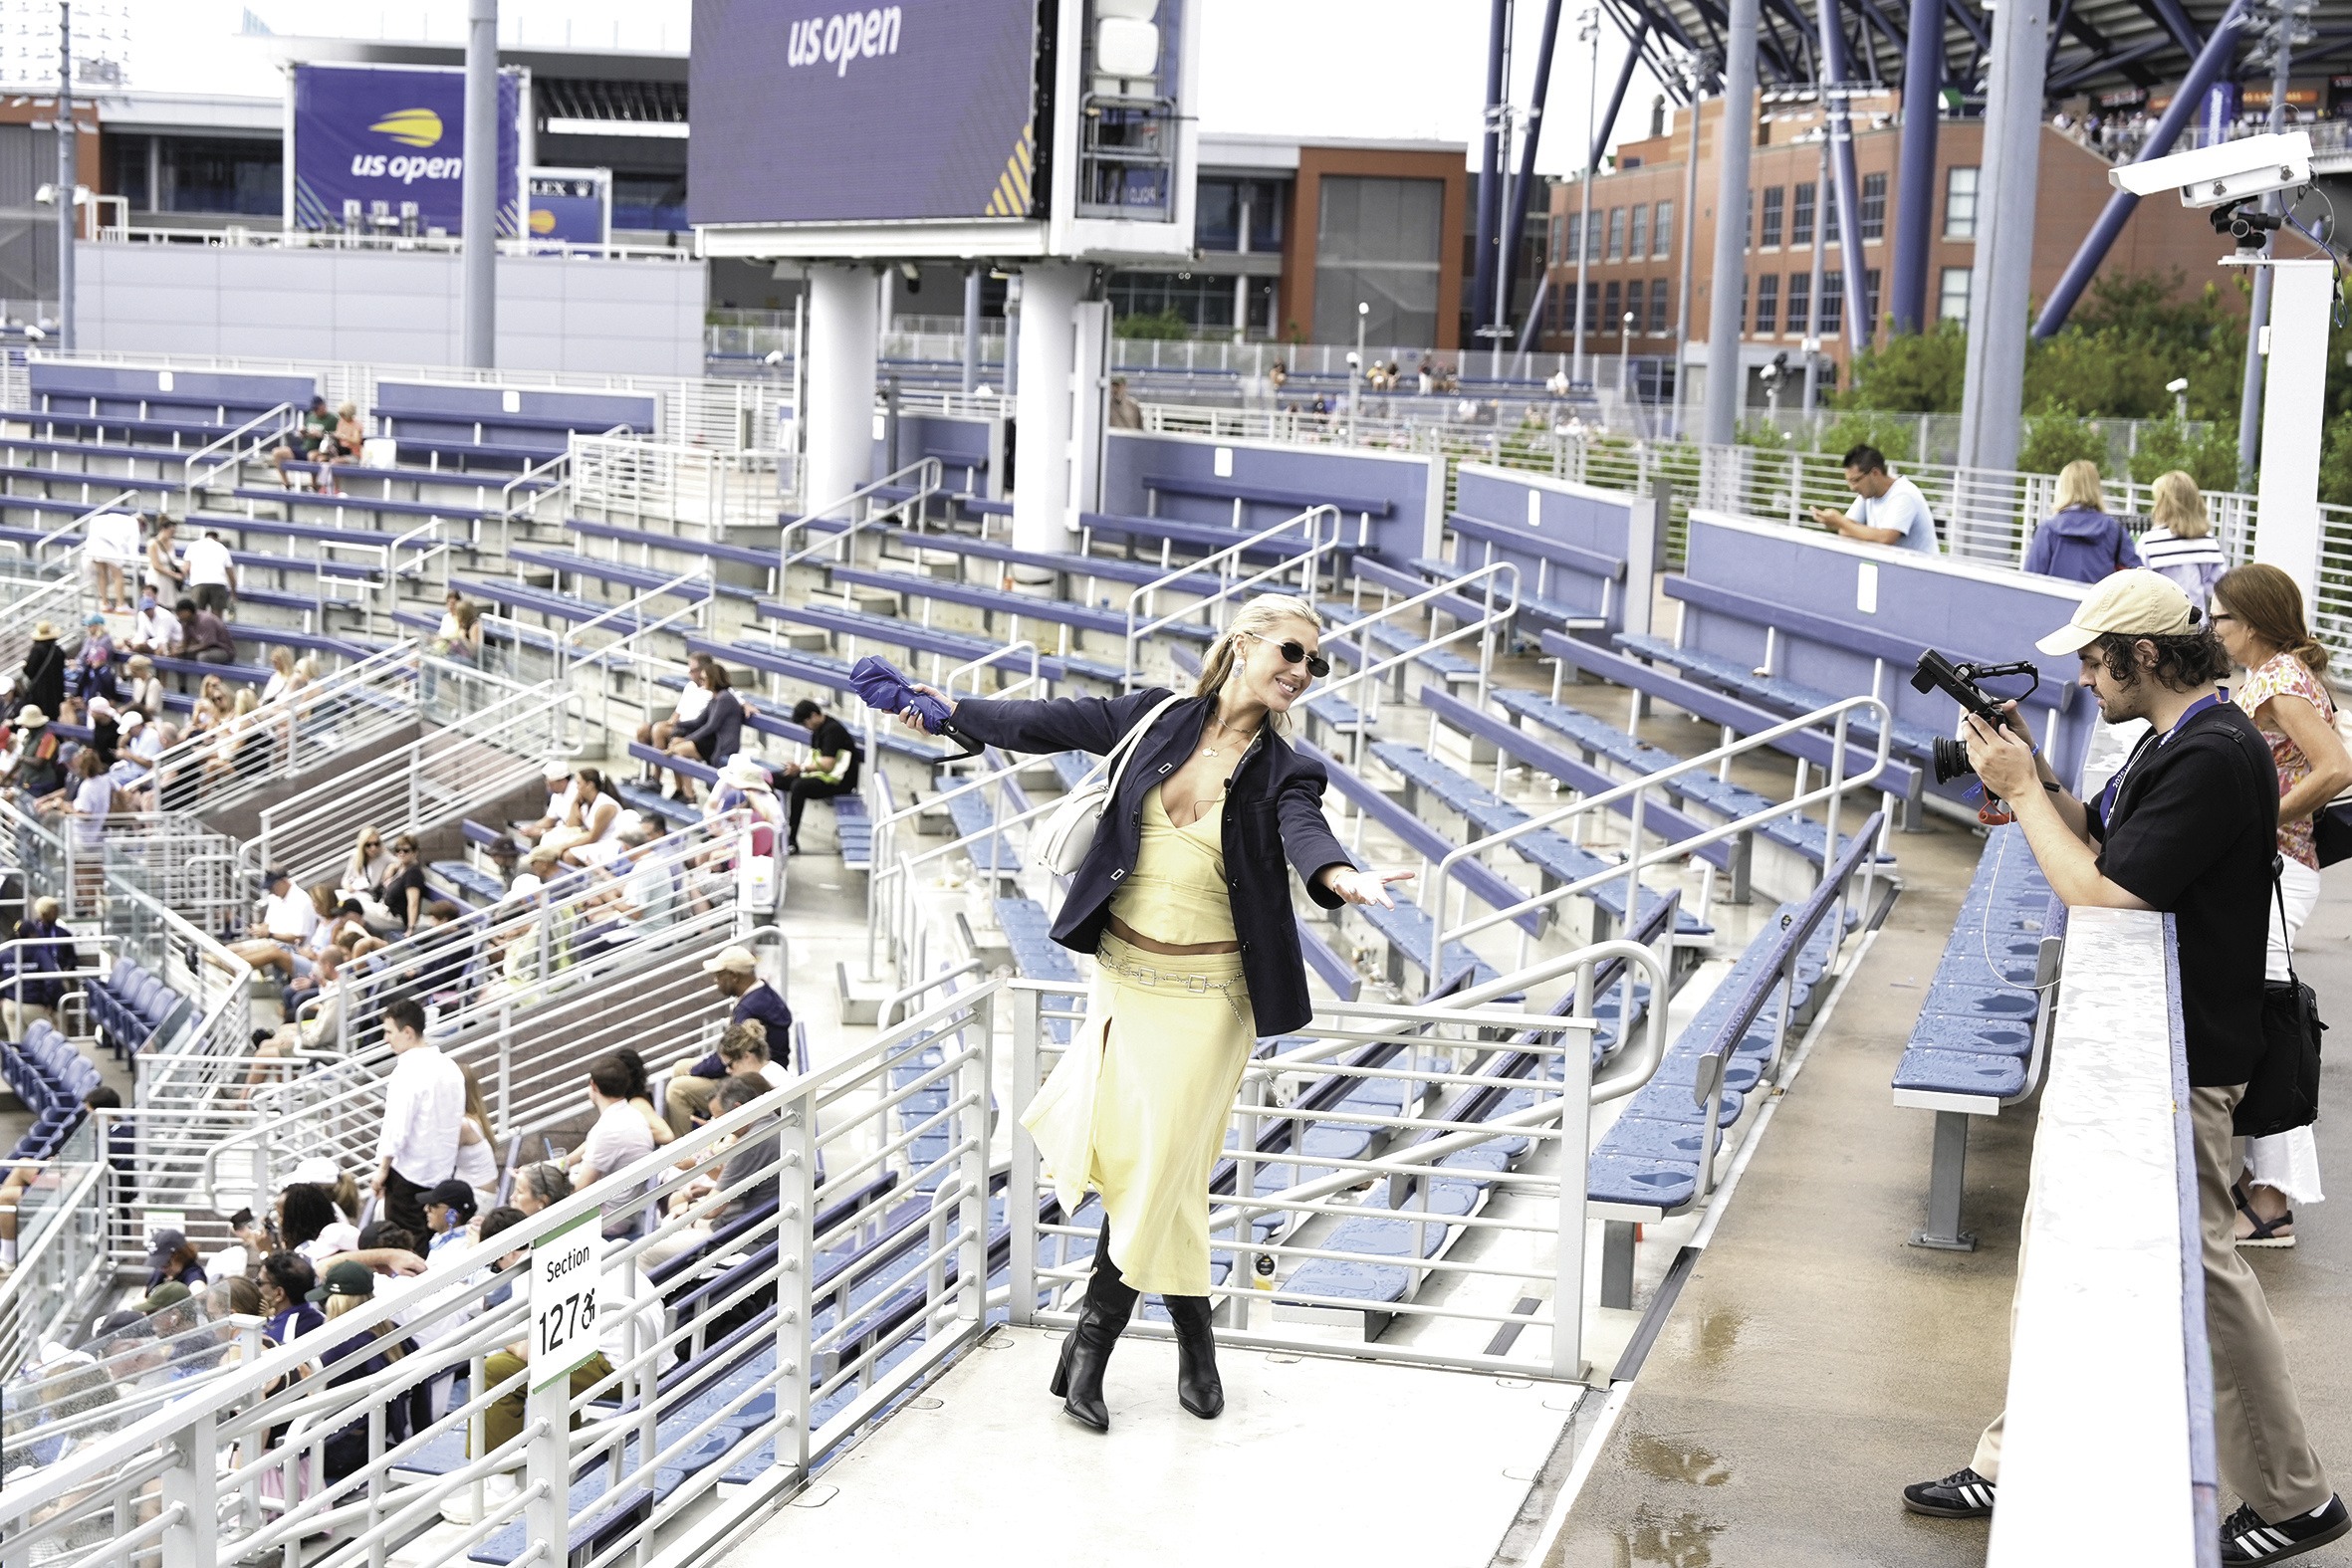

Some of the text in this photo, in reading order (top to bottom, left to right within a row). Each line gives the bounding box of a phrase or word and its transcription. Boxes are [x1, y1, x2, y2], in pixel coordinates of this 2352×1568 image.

[787, 4, 903, 78] us open
[351, 153, 464, 185] us open
[529, 179, 568, 197] LEX
[547, 1245, 590, 1283] Section
[539, 1292, 581, 1356] 127
